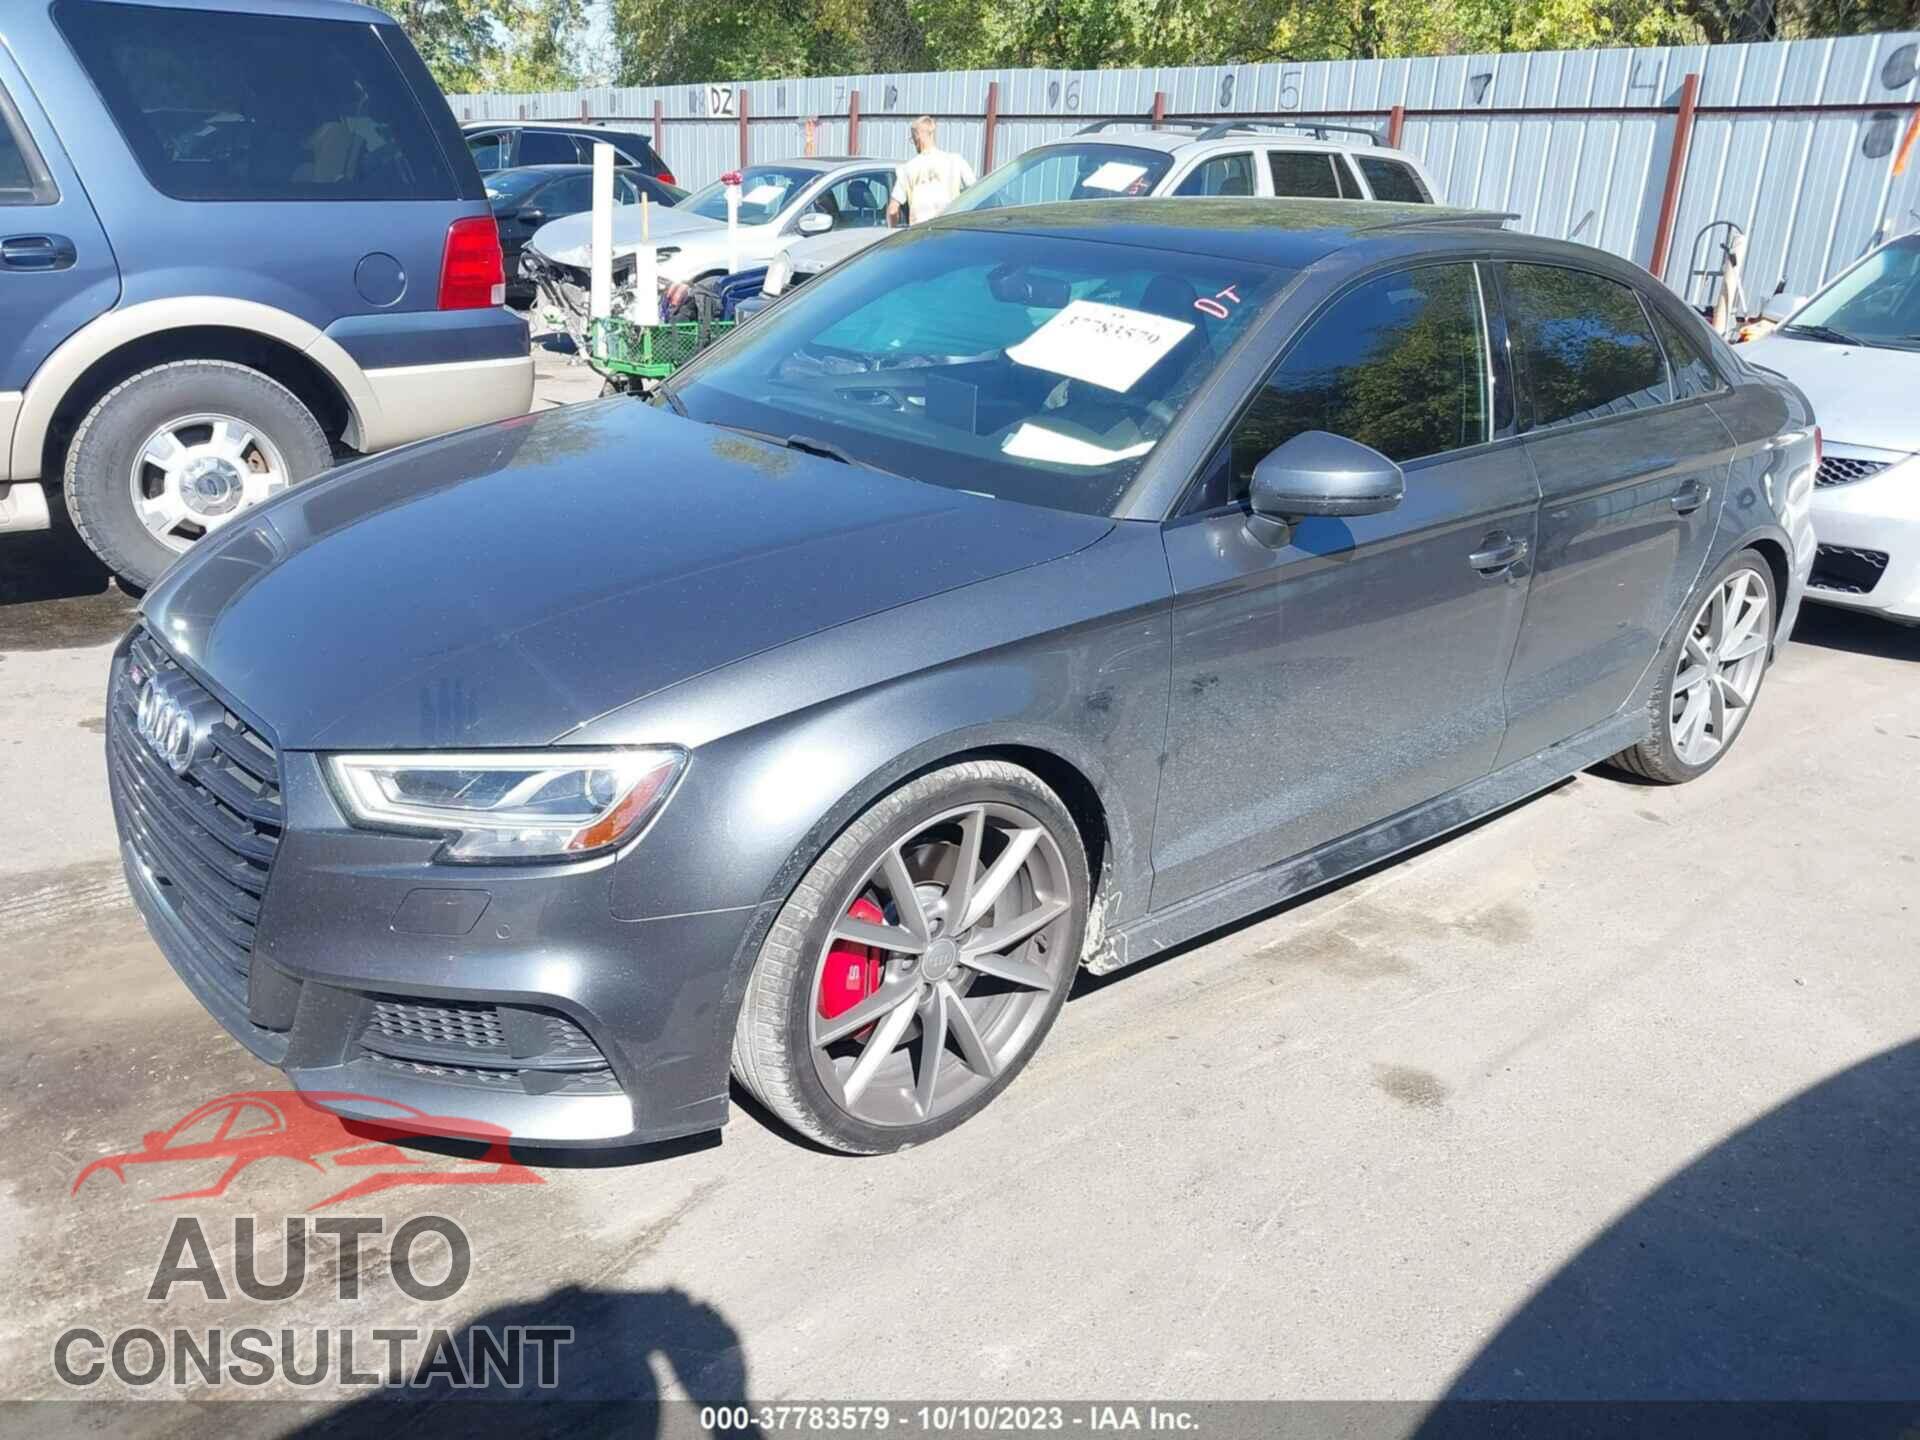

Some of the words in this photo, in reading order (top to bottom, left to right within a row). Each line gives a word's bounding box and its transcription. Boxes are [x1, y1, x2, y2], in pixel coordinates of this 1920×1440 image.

[1220, 74, 1235, 108] 8
[1280, 71, 1301, 110] 5
[1470, 73, 1493, 104] 7
[1631, 59, 1663, 103] 4
[711, 87, 735, 116] DZ
